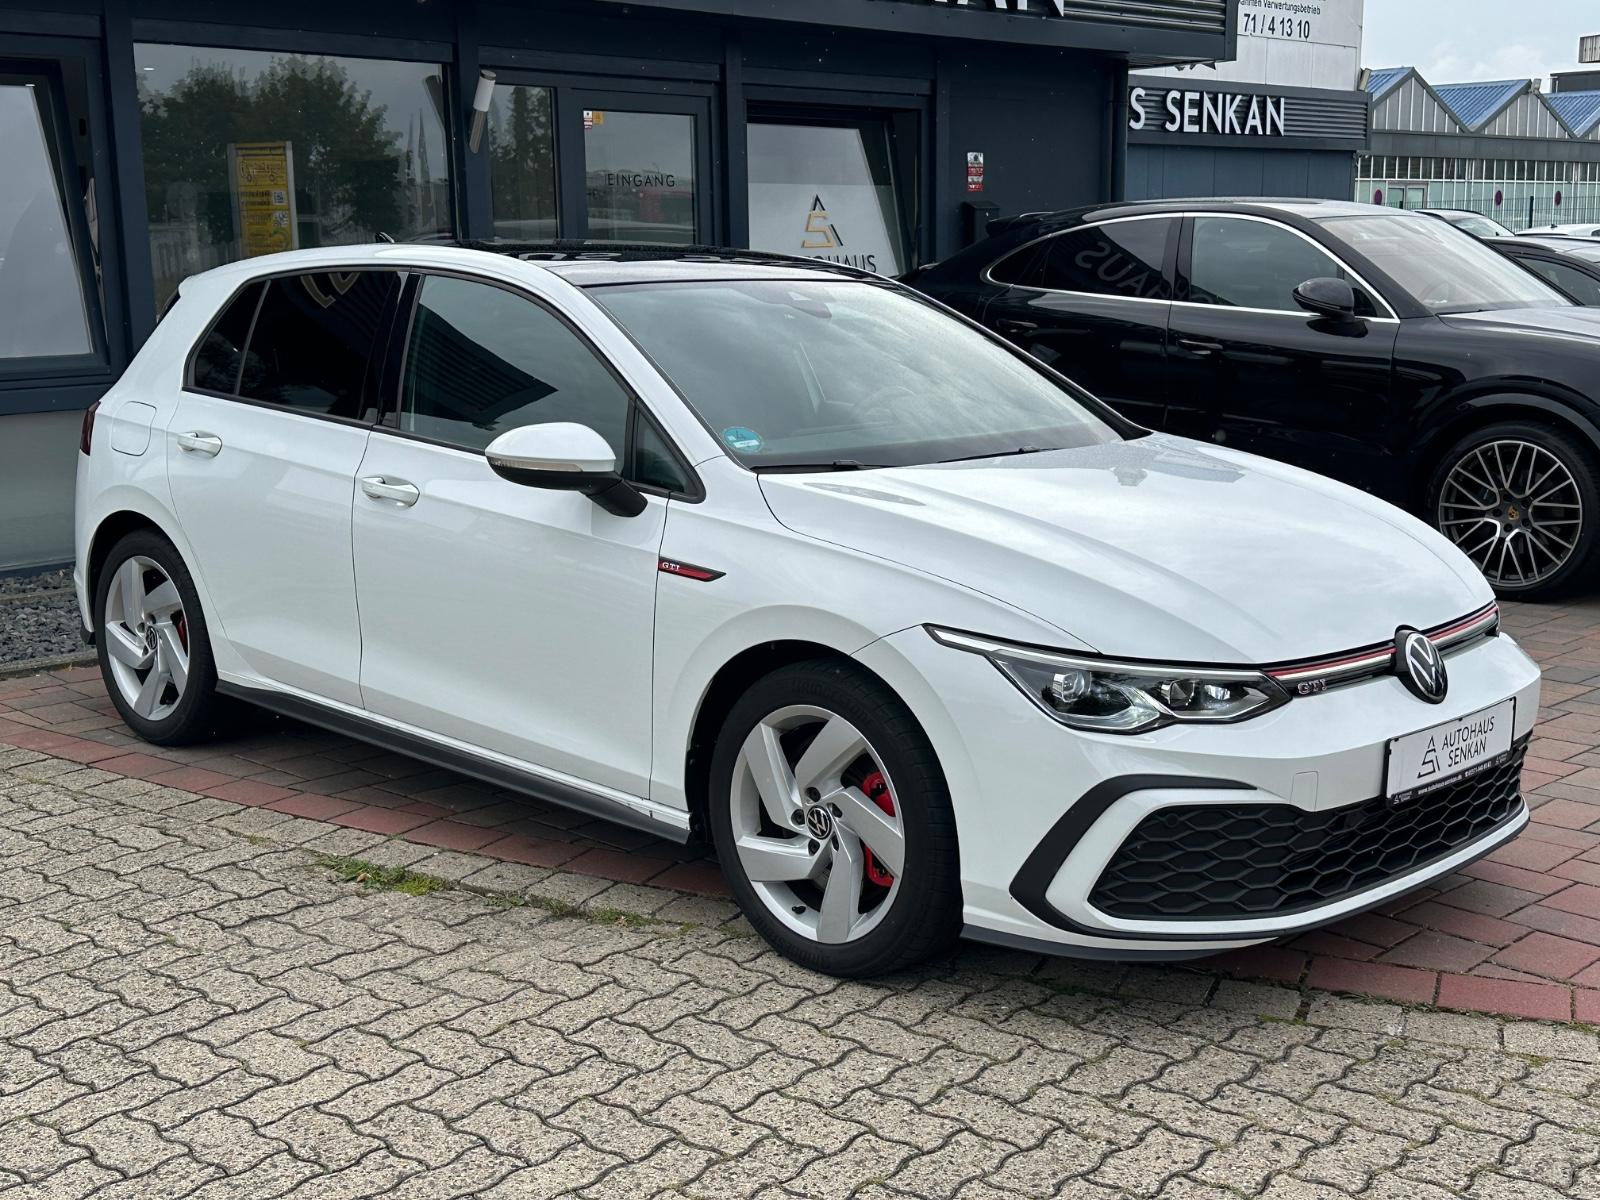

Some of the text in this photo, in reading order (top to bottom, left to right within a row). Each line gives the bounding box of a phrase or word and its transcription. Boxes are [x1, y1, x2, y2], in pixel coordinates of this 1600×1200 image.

[1243, 13, 1257, 33] 71
[1279, 17, 1293, 37] 13
[1296, 19, 1311, 39] 10
[1164, 89, 1286, 136] SENKAN
[606, 173, 676, 188] EINGANG
[661, 561, 681, 572] GTI
[1297, 678, 1328, 695] GTI
[1441, 715, 1496, 751] AUTOHAUS
[1447, 736, 1488, 768] SENKAN
